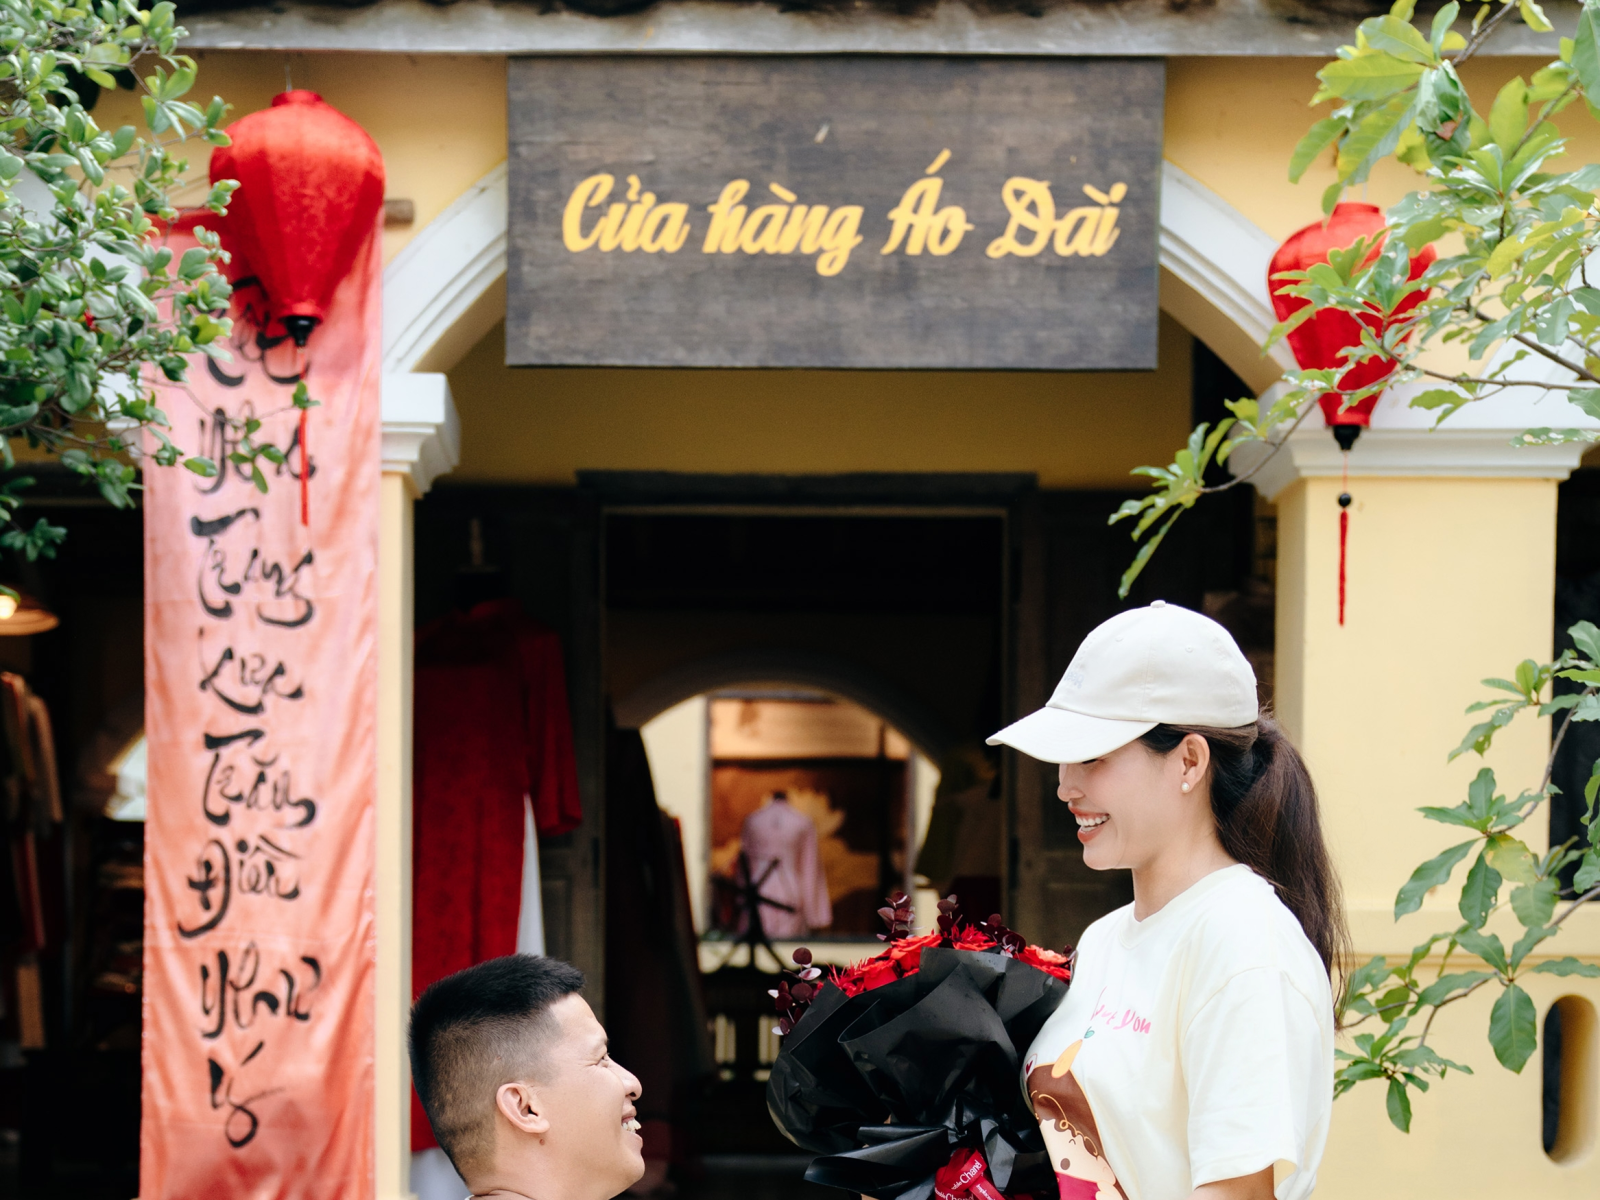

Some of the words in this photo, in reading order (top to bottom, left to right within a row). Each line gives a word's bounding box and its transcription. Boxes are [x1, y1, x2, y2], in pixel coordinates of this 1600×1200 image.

[562, 173, 691, 253] Cửa
[702, 178, 865, 277] hàng
[881, 148, 976, 256] Áo
[959, 1159, 983, 1184] Chanel
